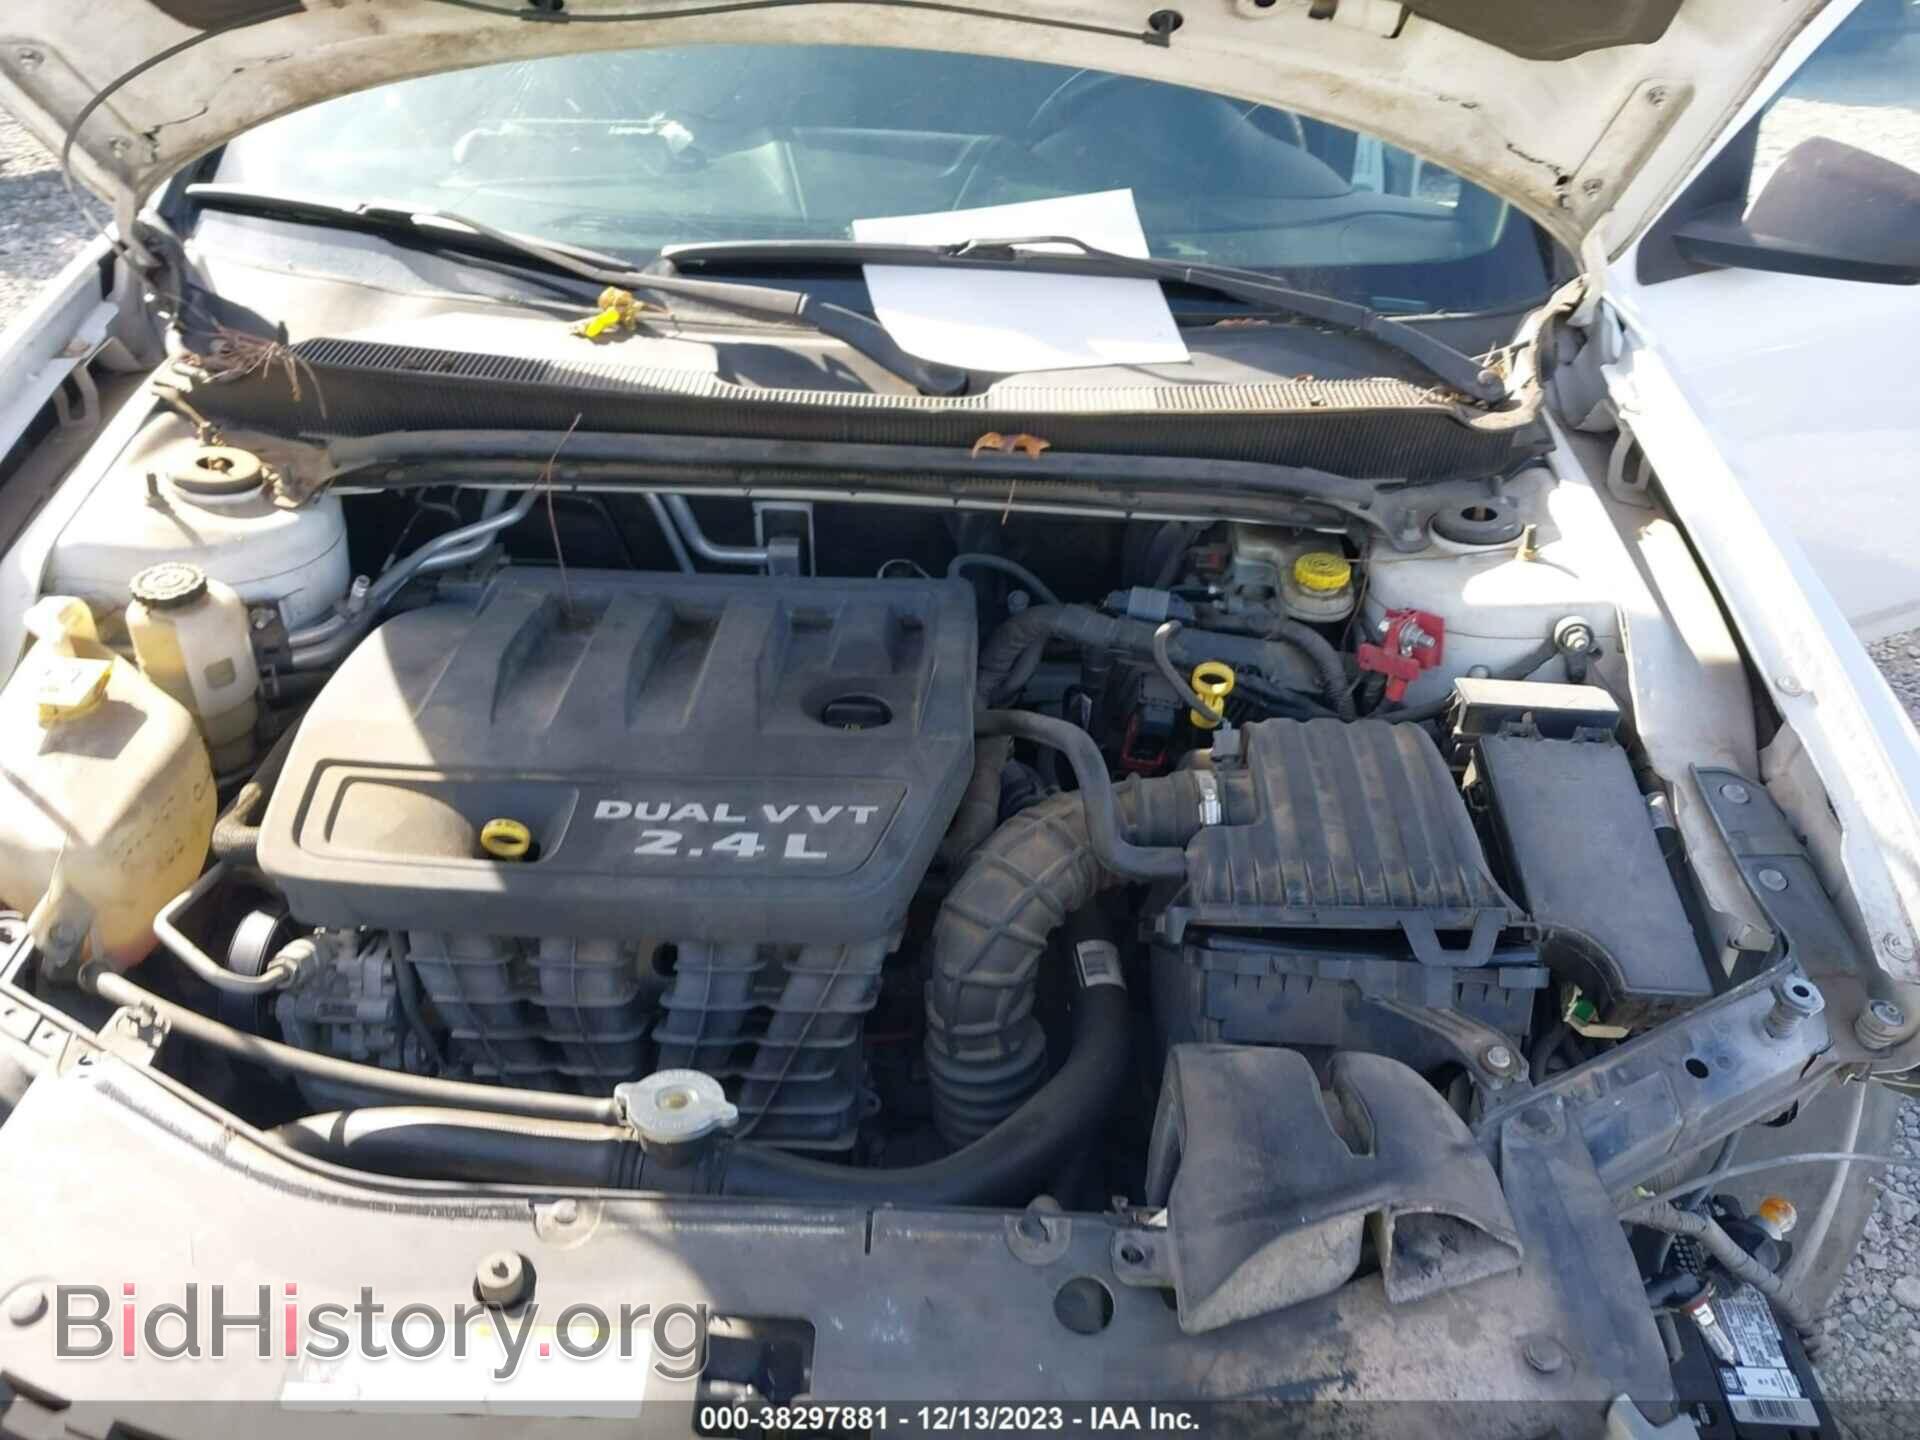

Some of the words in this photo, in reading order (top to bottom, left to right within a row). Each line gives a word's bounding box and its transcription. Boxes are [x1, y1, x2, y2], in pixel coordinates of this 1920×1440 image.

[594, 800, 746, 822] DUAL
[761, 803, 879, 824] VVT
[633, 829, 766, 857] 2.4
[783, 833, 828, 859] L
